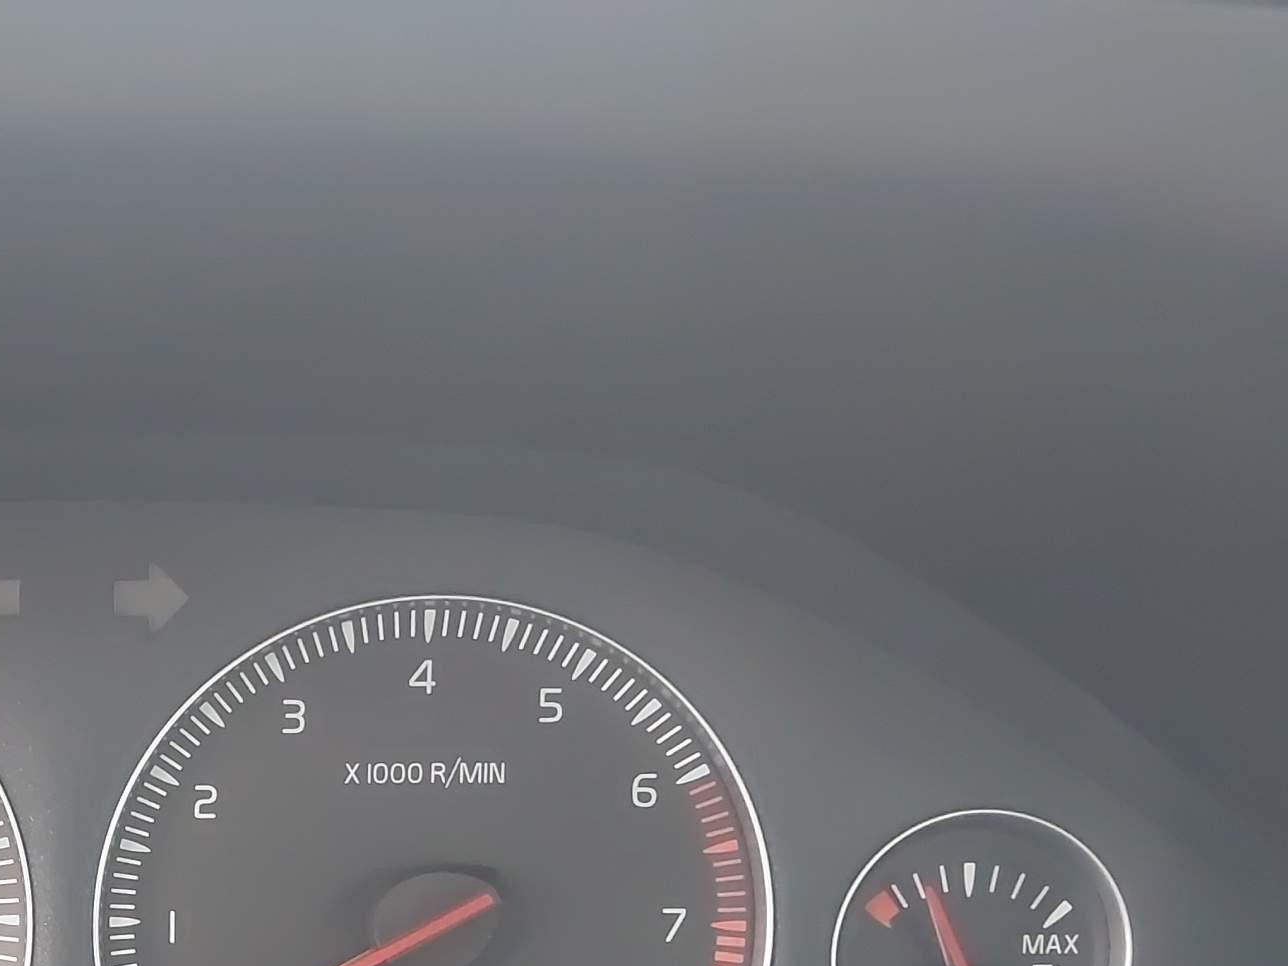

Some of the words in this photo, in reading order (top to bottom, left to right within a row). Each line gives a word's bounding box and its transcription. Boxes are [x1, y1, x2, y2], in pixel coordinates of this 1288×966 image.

[409, 660, 436, 695] 4
[282, 699, 306, 734] 3
[538, 688, 563, 723] 5
[344, 763, 360, 784] X
[365, 763, 423, 784] 1000
[430, 757, 506, 785] R/MIN
[193, 785, 217, 820] 2
[631, 774, 657, 808] 6
[169, 911, 175, 944] 1
[662, 908, 687, 943] 7
[1022, 935, 1078, 955] MAX
